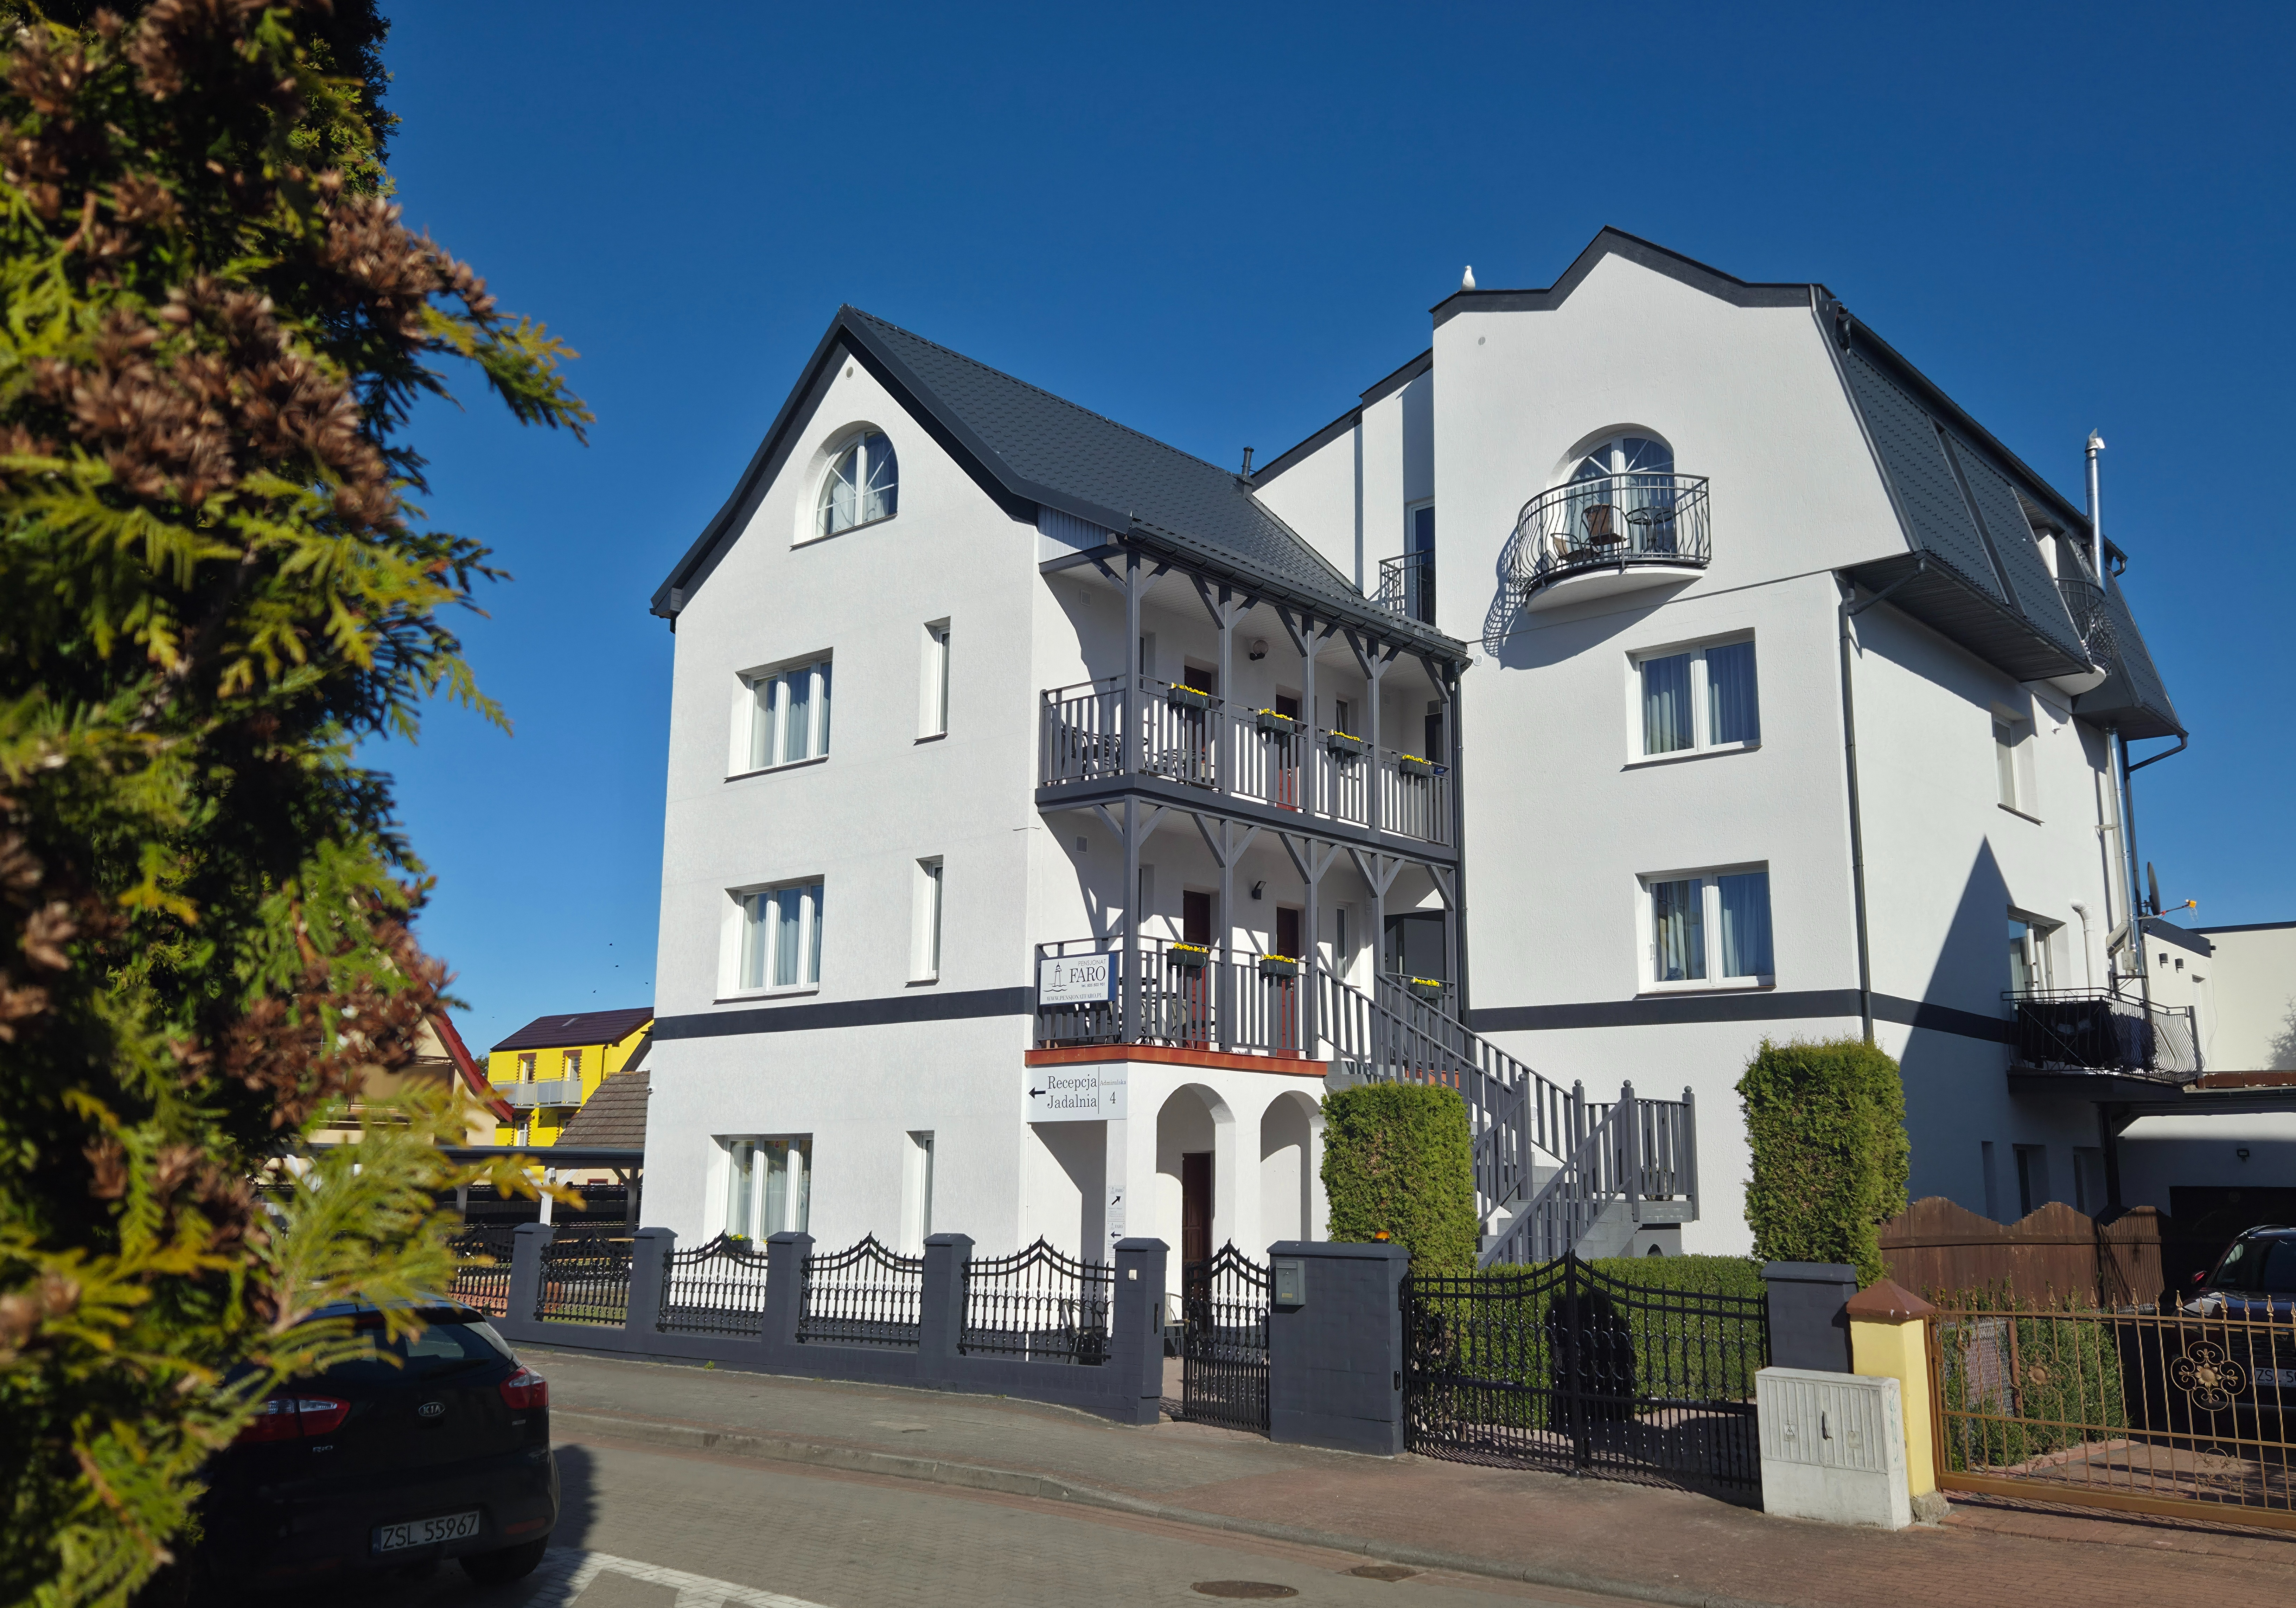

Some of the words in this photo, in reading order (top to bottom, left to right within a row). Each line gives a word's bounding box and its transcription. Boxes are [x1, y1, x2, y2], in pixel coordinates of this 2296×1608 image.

[1069, 966, 1105, 983] FARO
[1048, 1074, 1097, 1091] Recepcja
[1047, 1094, 1097, 1108] Jadalnia
[1110, 1091, 1116, 1103] 4
[2256, 1369, 2281, 1382] ZS
[2286, 1371, 2296, 1383] 5
[423, 1405, 441, 1414] KIA
[383, 1524, 417, 1549] ZSL
[425, 1513, 477, 1542] 55967
